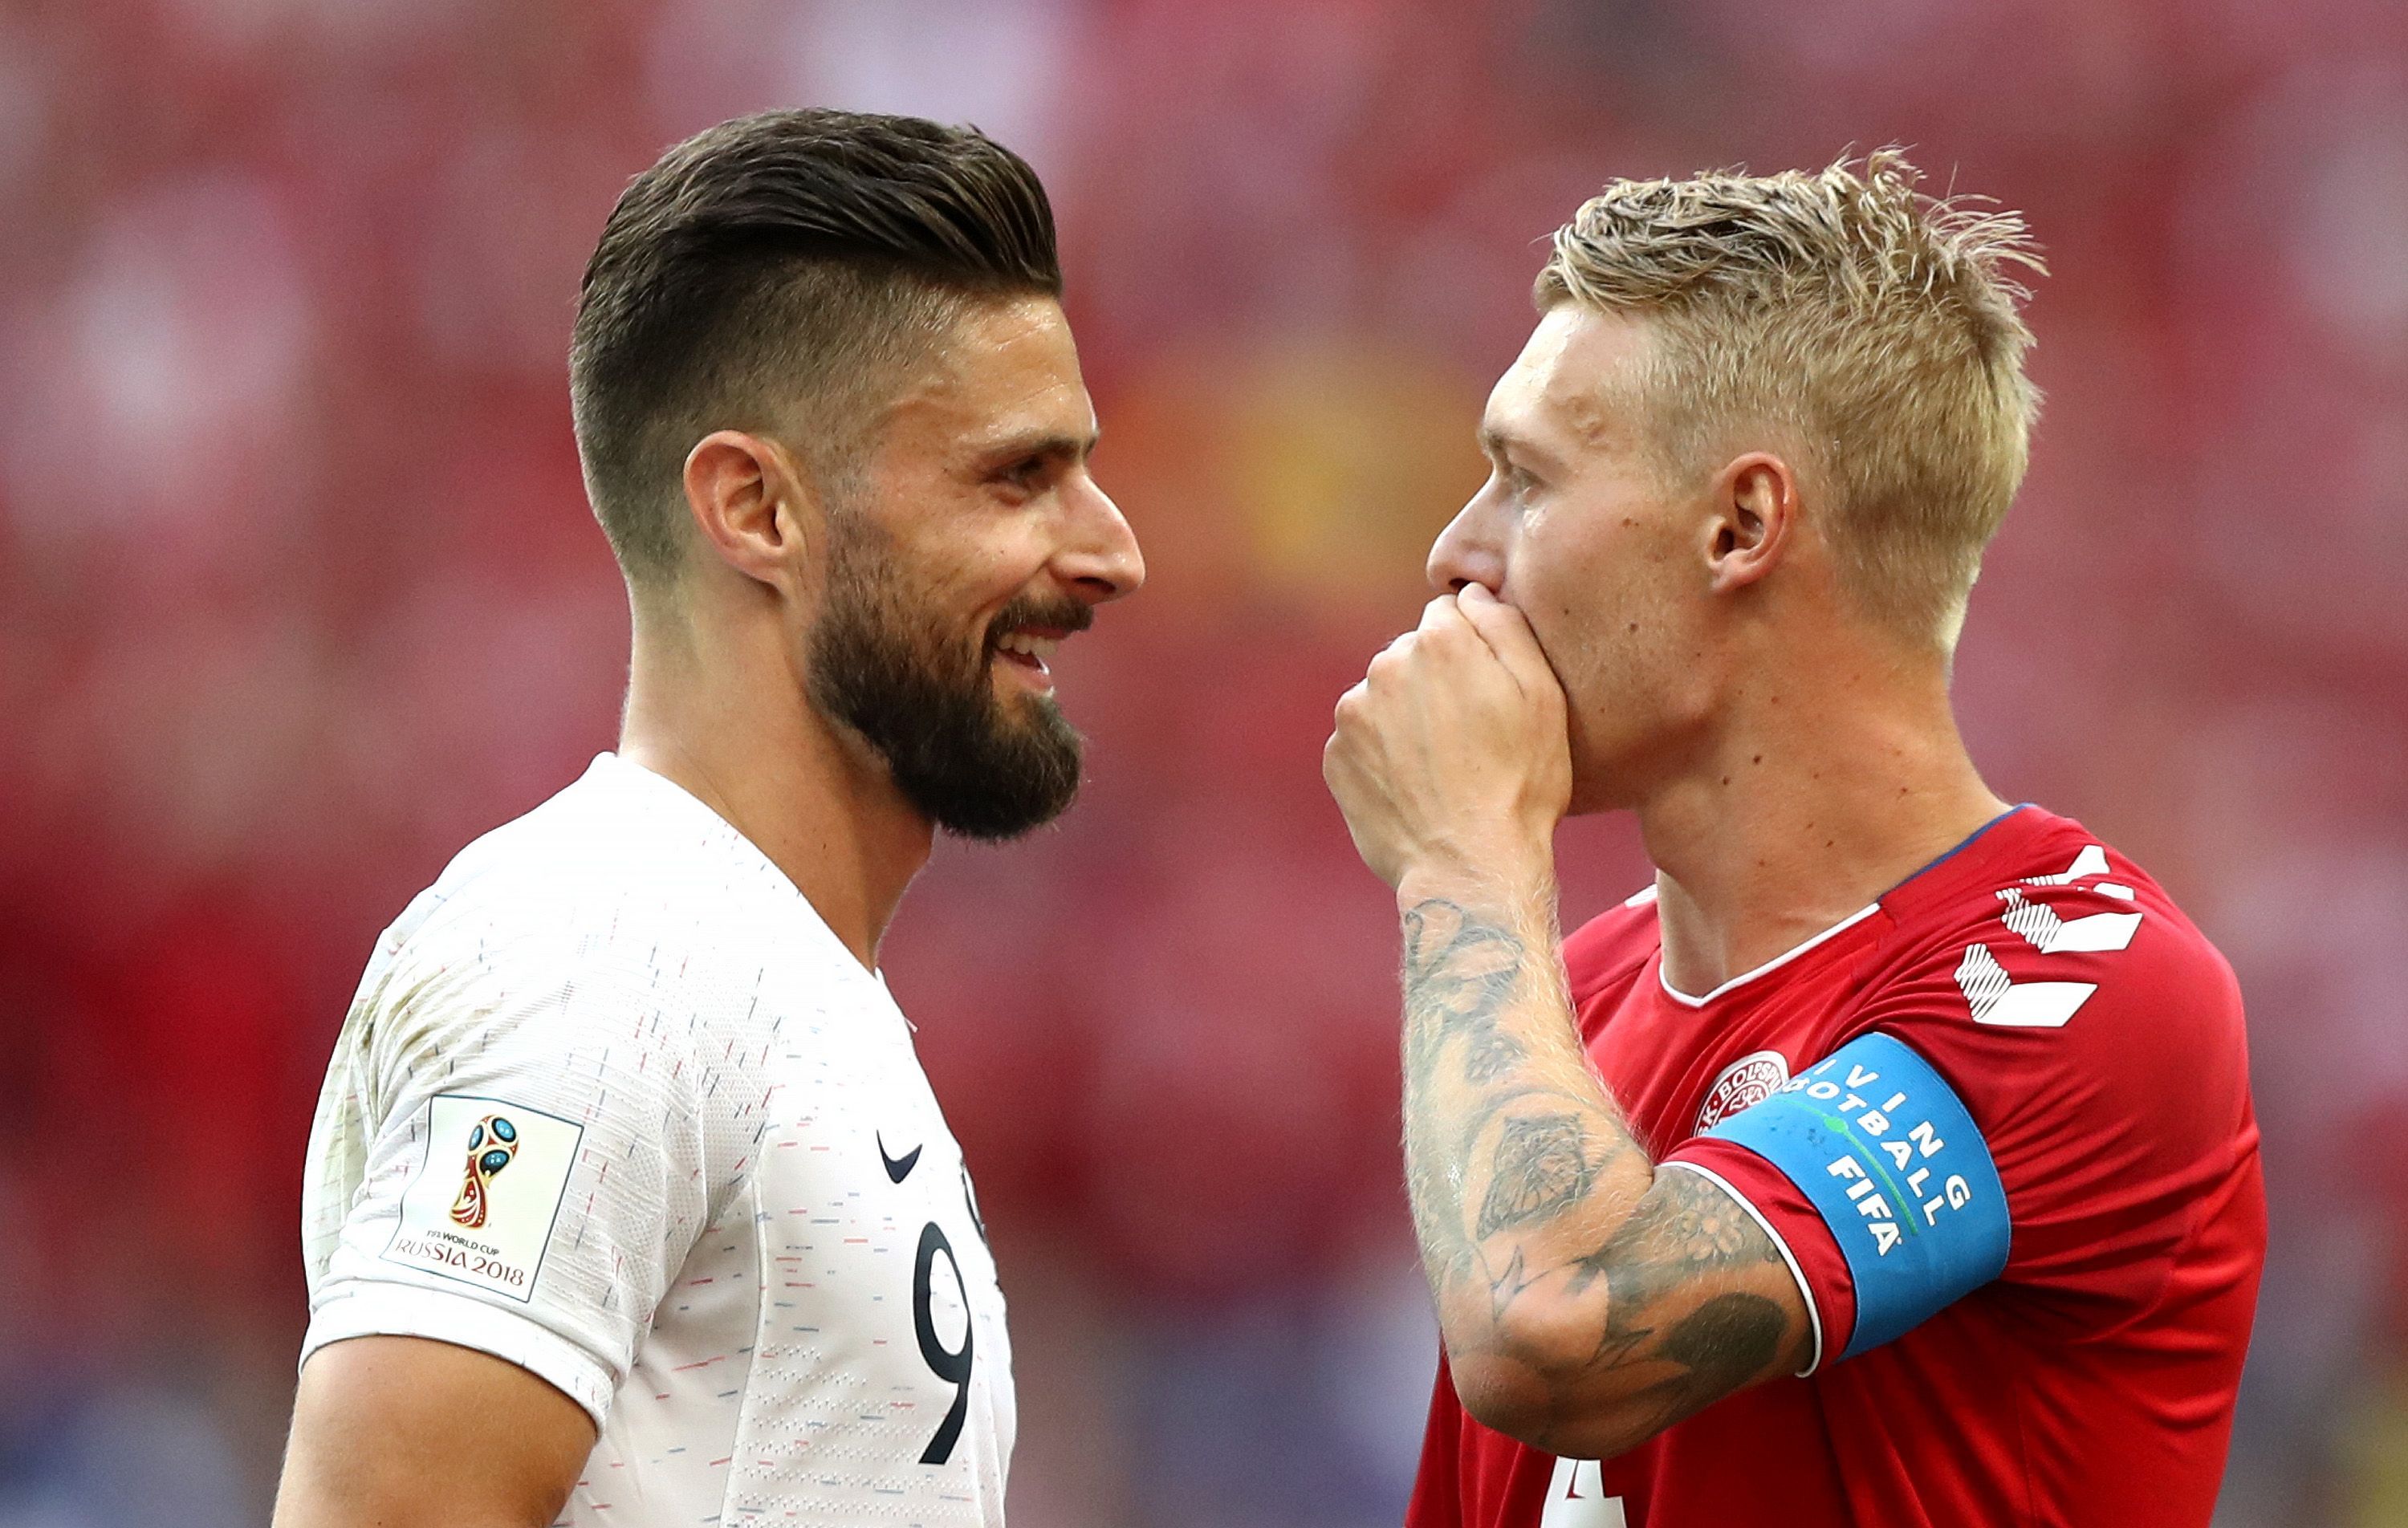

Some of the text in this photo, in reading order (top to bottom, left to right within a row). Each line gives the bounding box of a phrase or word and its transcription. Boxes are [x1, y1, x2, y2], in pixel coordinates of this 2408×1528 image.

[1781, 1076, 1947, 1227] OOTBALL
[1812, 1058, 1972, 1212] IVING
[395, 1237, 524, 1287] RUSSIA 2018
[442, 1231, 479, 1250] WORLD
[479, 1244, 500, 1256] CUP
[1826, 1154, 1900, 1258] FIFA
[912, 1221, 974, 1465] 9
